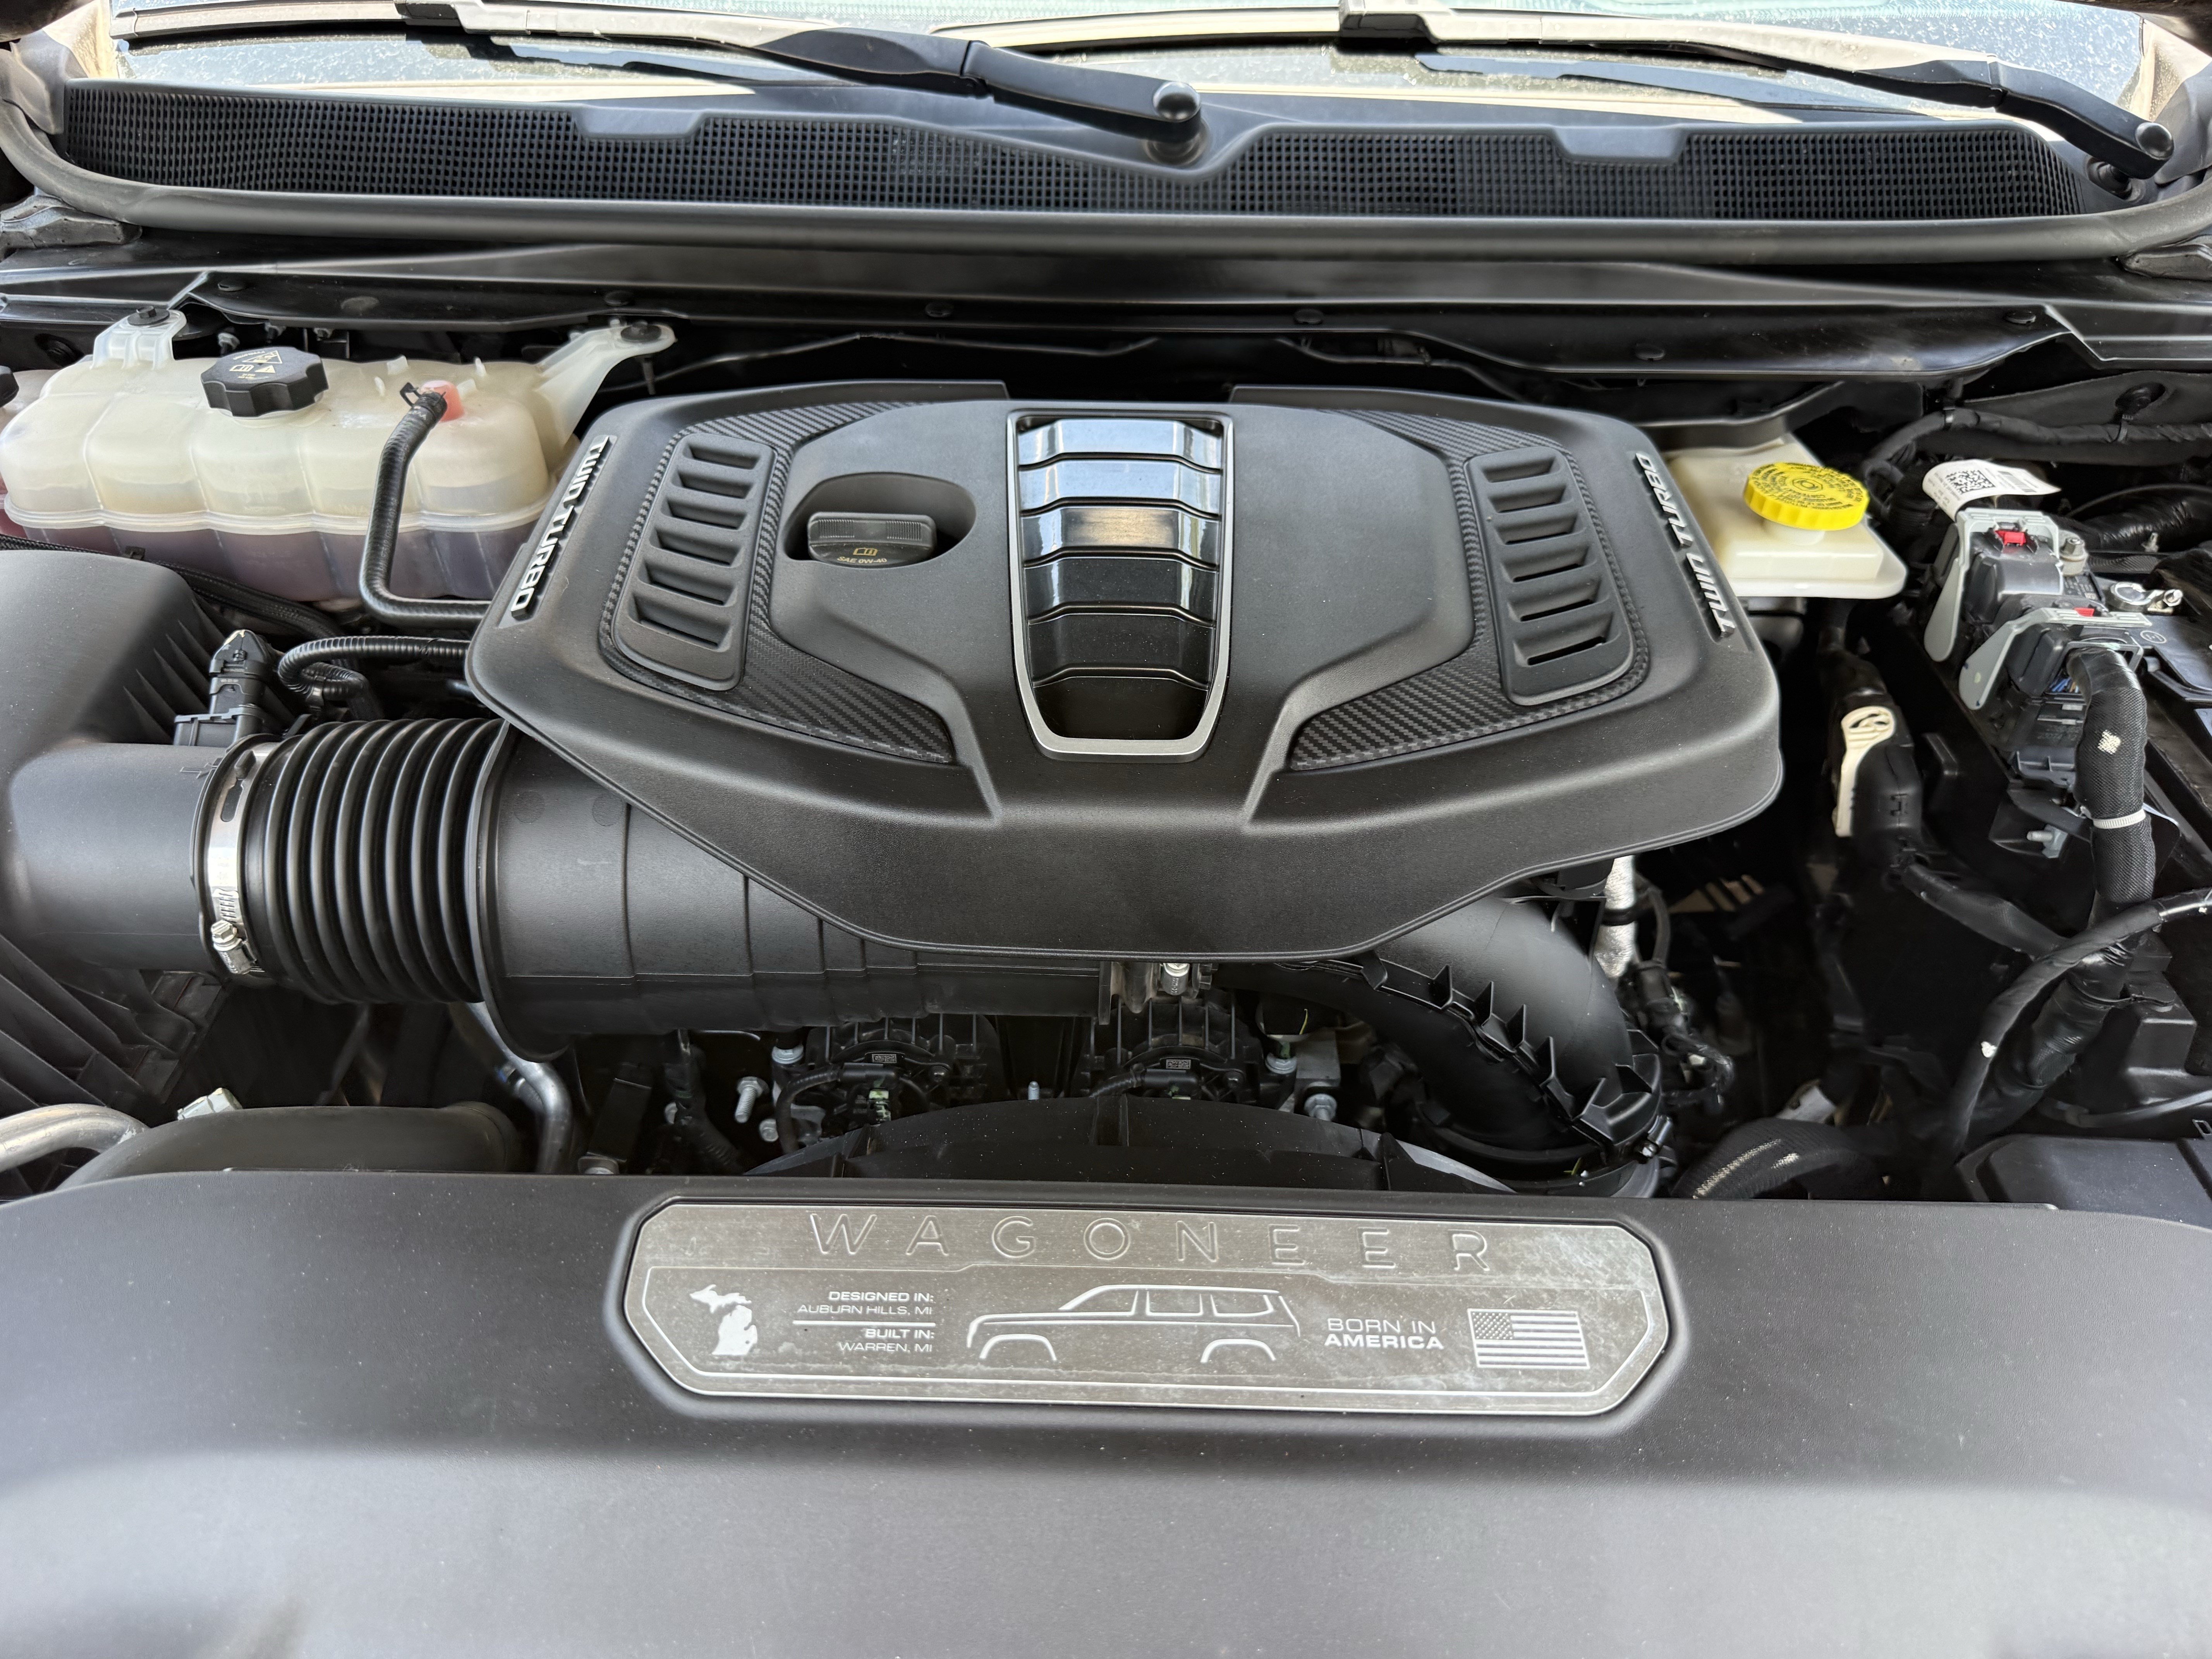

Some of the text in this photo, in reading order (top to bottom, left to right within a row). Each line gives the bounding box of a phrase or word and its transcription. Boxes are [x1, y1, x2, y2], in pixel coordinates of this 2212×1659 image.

[510, 436, 610, 614] TWIN TURBO
[1635, 453, 1735, 635] TWIN TURBO
[809, 1213, 1491, 1272] WAGONEER
[828, 1291, 934, 1302] DESIGNED IN:
[797, 1304, 932, 1316] AUBURN HILLS, MI
[864, 1328, 934, 1339] BUILT IN:
[1327, 1318, 1436, 1334] BORN IN
[838, 1342, 933, 1353] WARREN, MI
[1324, 1334, 1444, 1350] AMERICA
